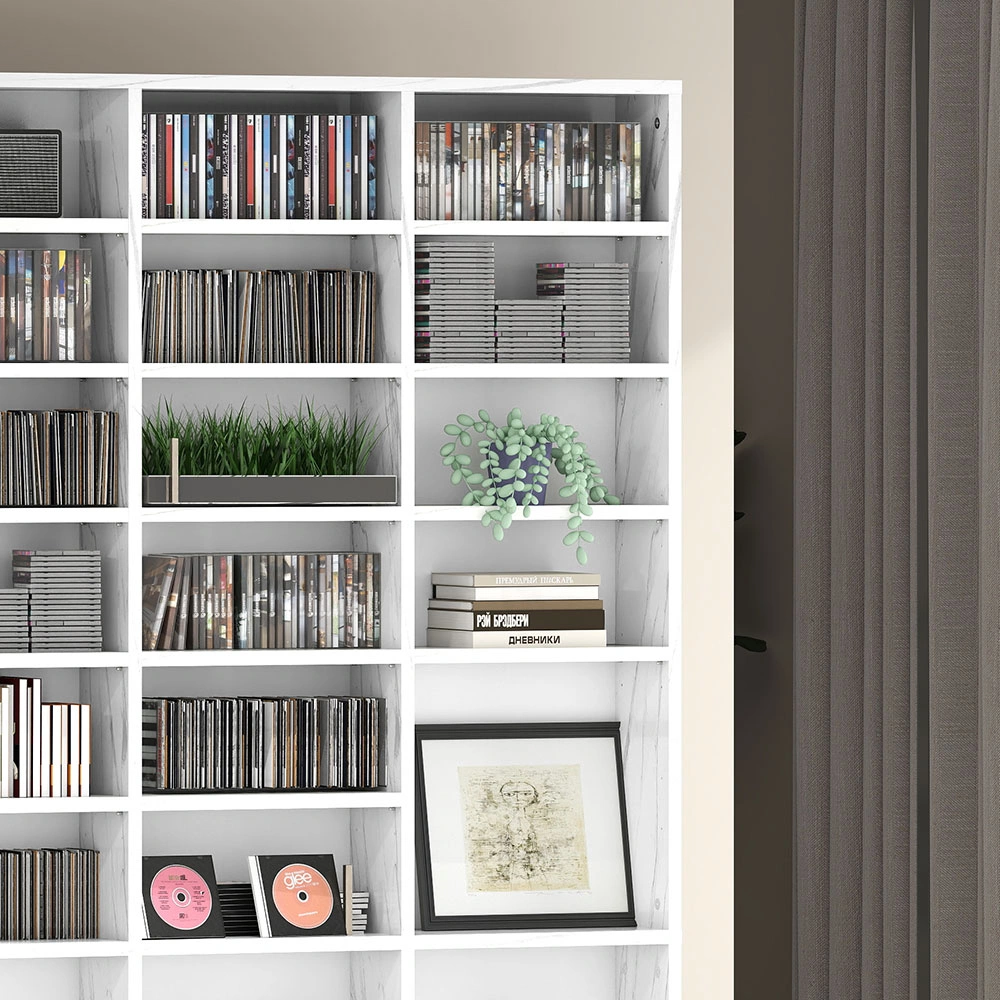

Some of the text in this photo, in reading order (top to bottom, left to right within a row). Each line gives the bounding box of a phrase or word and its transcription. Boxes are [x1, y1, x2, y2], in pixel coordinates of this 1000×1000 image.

[476, 611, 529, 628] РЭЙ БРЭДБЕРИ
[508, 635, 561, 645] ДНЕВНИКИ
[284, 872, 312, 890] glee
